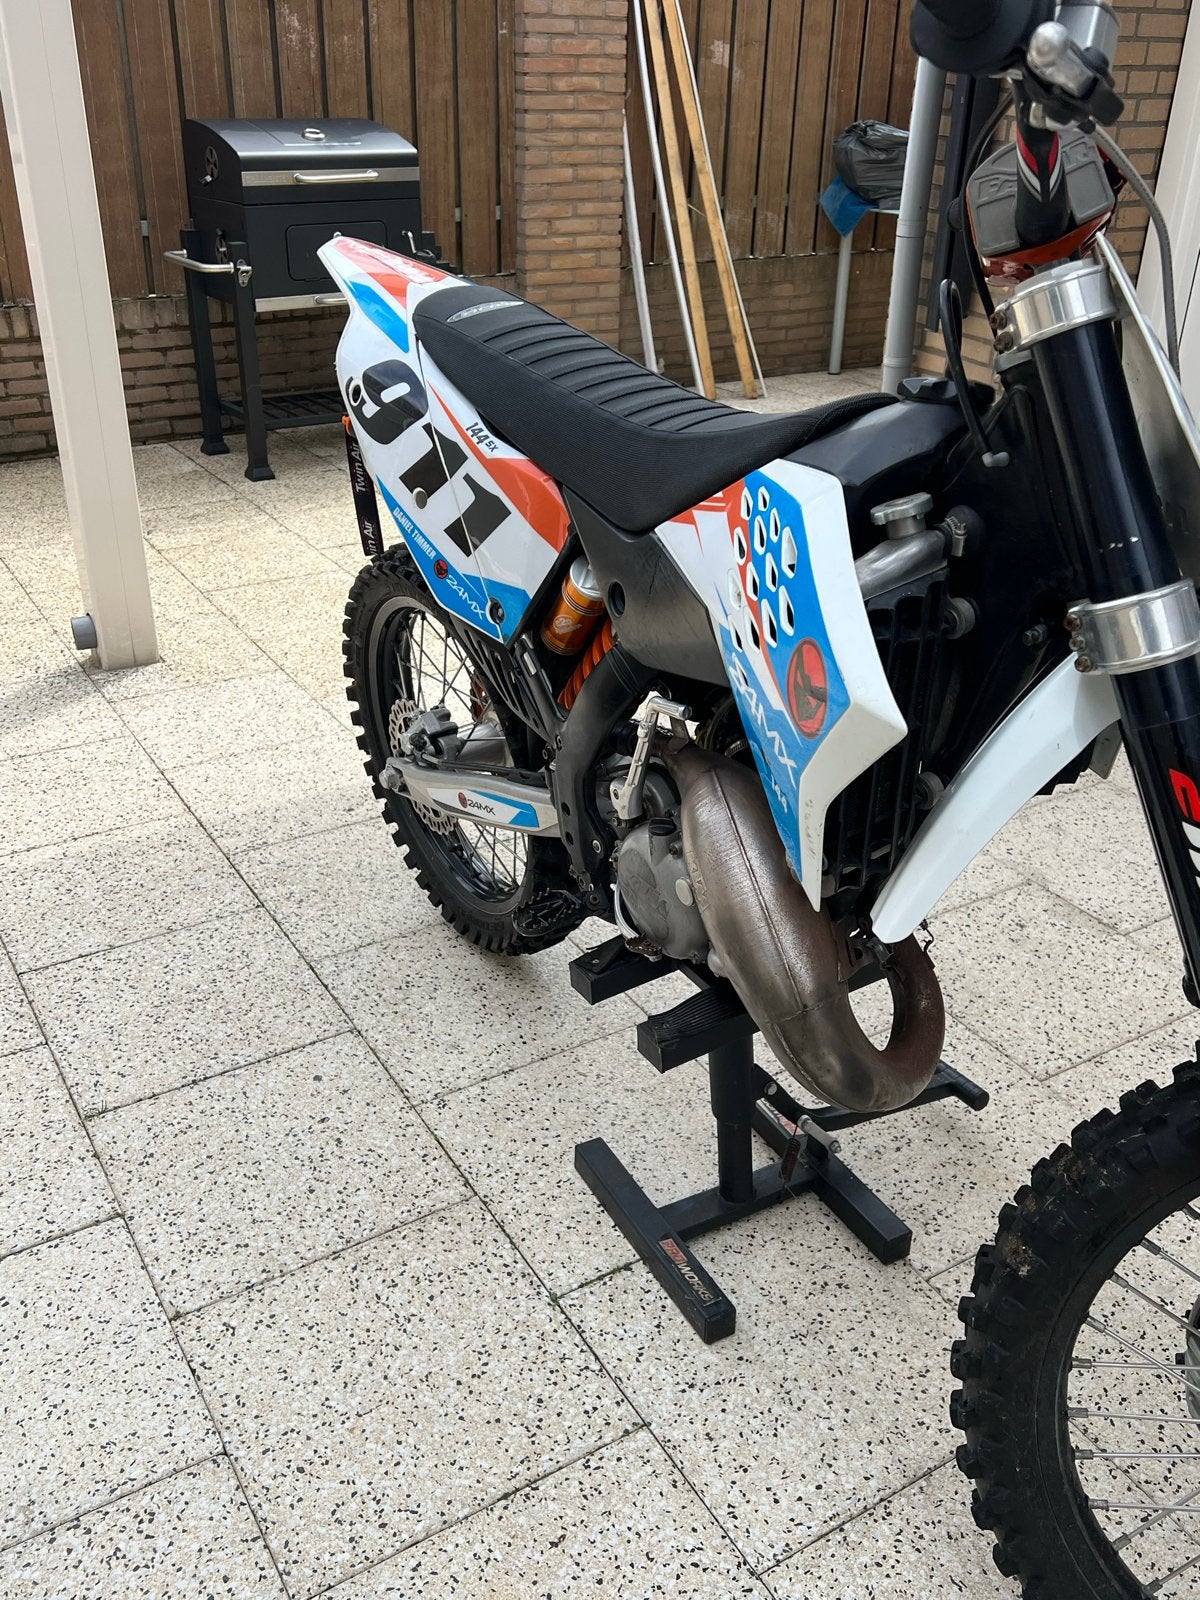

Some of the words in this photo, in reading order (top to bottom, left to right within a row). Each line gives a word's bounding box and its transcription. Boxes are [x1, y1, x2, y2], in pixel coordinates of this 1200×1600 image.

[466, 421, 490, 445] 144
[346, 359, 512, 558] 911
[354, 461, 366, 492] Twin
[364, 520, 374, 539] Air
[393, 507, 414, 534] DANIEL
[411, 529, 437, 560] TIMMER
[446, 574, 486, 620] 24MX
[467, 798, 496, 816] 24MX
